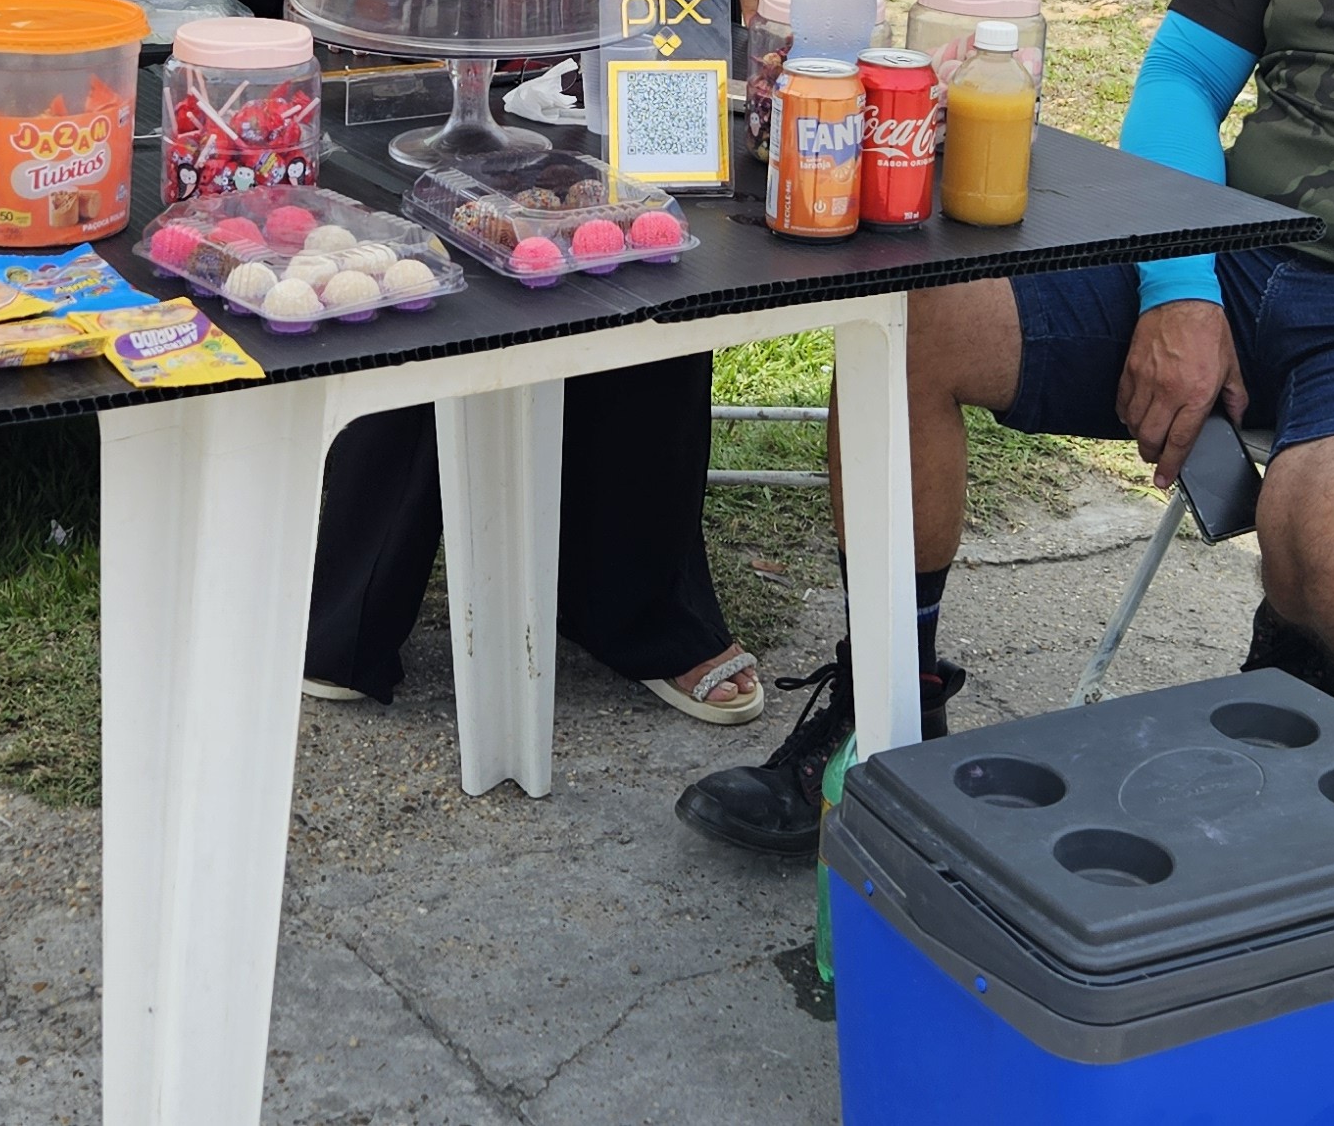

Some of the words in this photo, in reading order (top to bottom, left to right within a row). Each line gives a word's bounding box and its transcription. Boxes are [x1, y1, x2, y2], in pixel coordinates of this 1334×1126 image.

[18, 120, 108, 155] JAZAM
[800, 160, 831, 171] laranja
[877, 159, 908, 167] SABOR
[27, 150, 105, 190] Tubitos
[0, 211, 13, 222] 50
